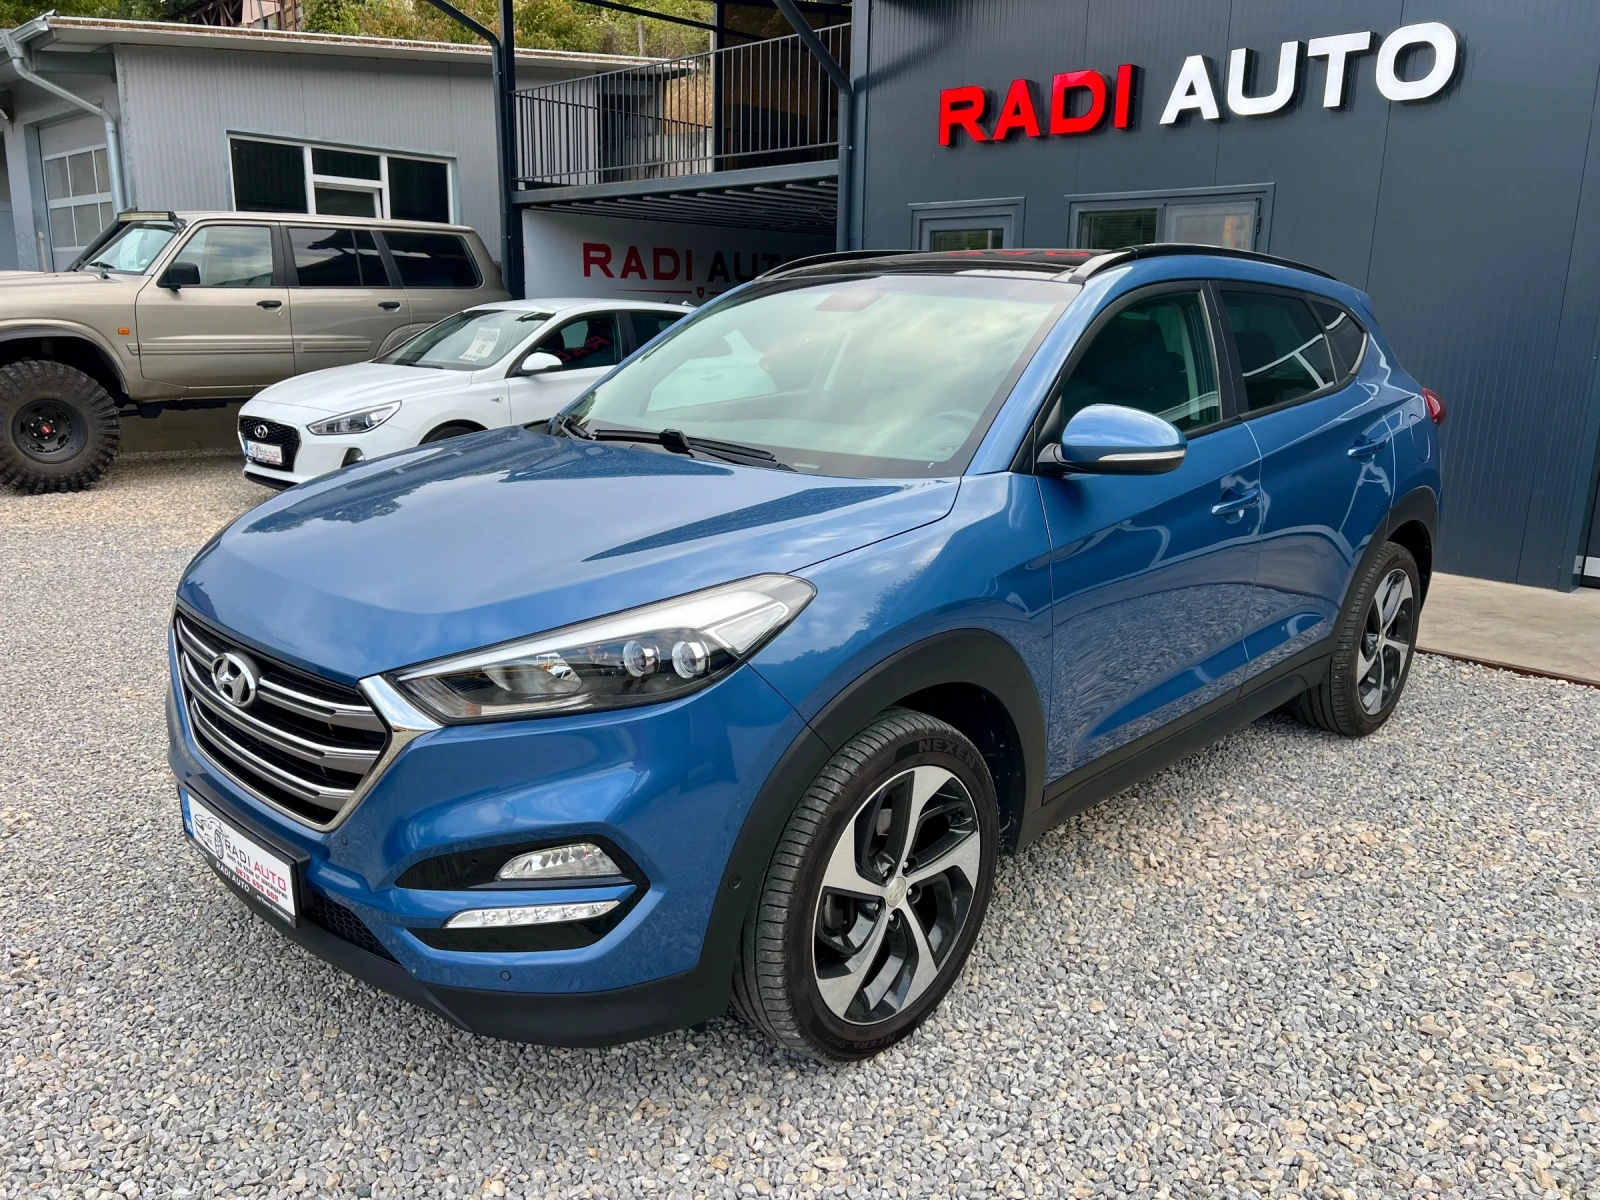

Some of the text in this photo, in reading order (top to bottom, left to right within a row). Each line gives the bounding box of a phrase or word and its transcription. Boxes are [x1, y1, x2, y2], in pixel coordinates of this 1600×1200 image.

[938, 21, 1459, 147] RADI AUTO
[583, 242, 803, 283] RADI AUT
[918, 738, 976, 769] NEXEN
[215, 861, 250, 893] RADI AUTO
[224, 838, 287, 892] RADI AUTO
